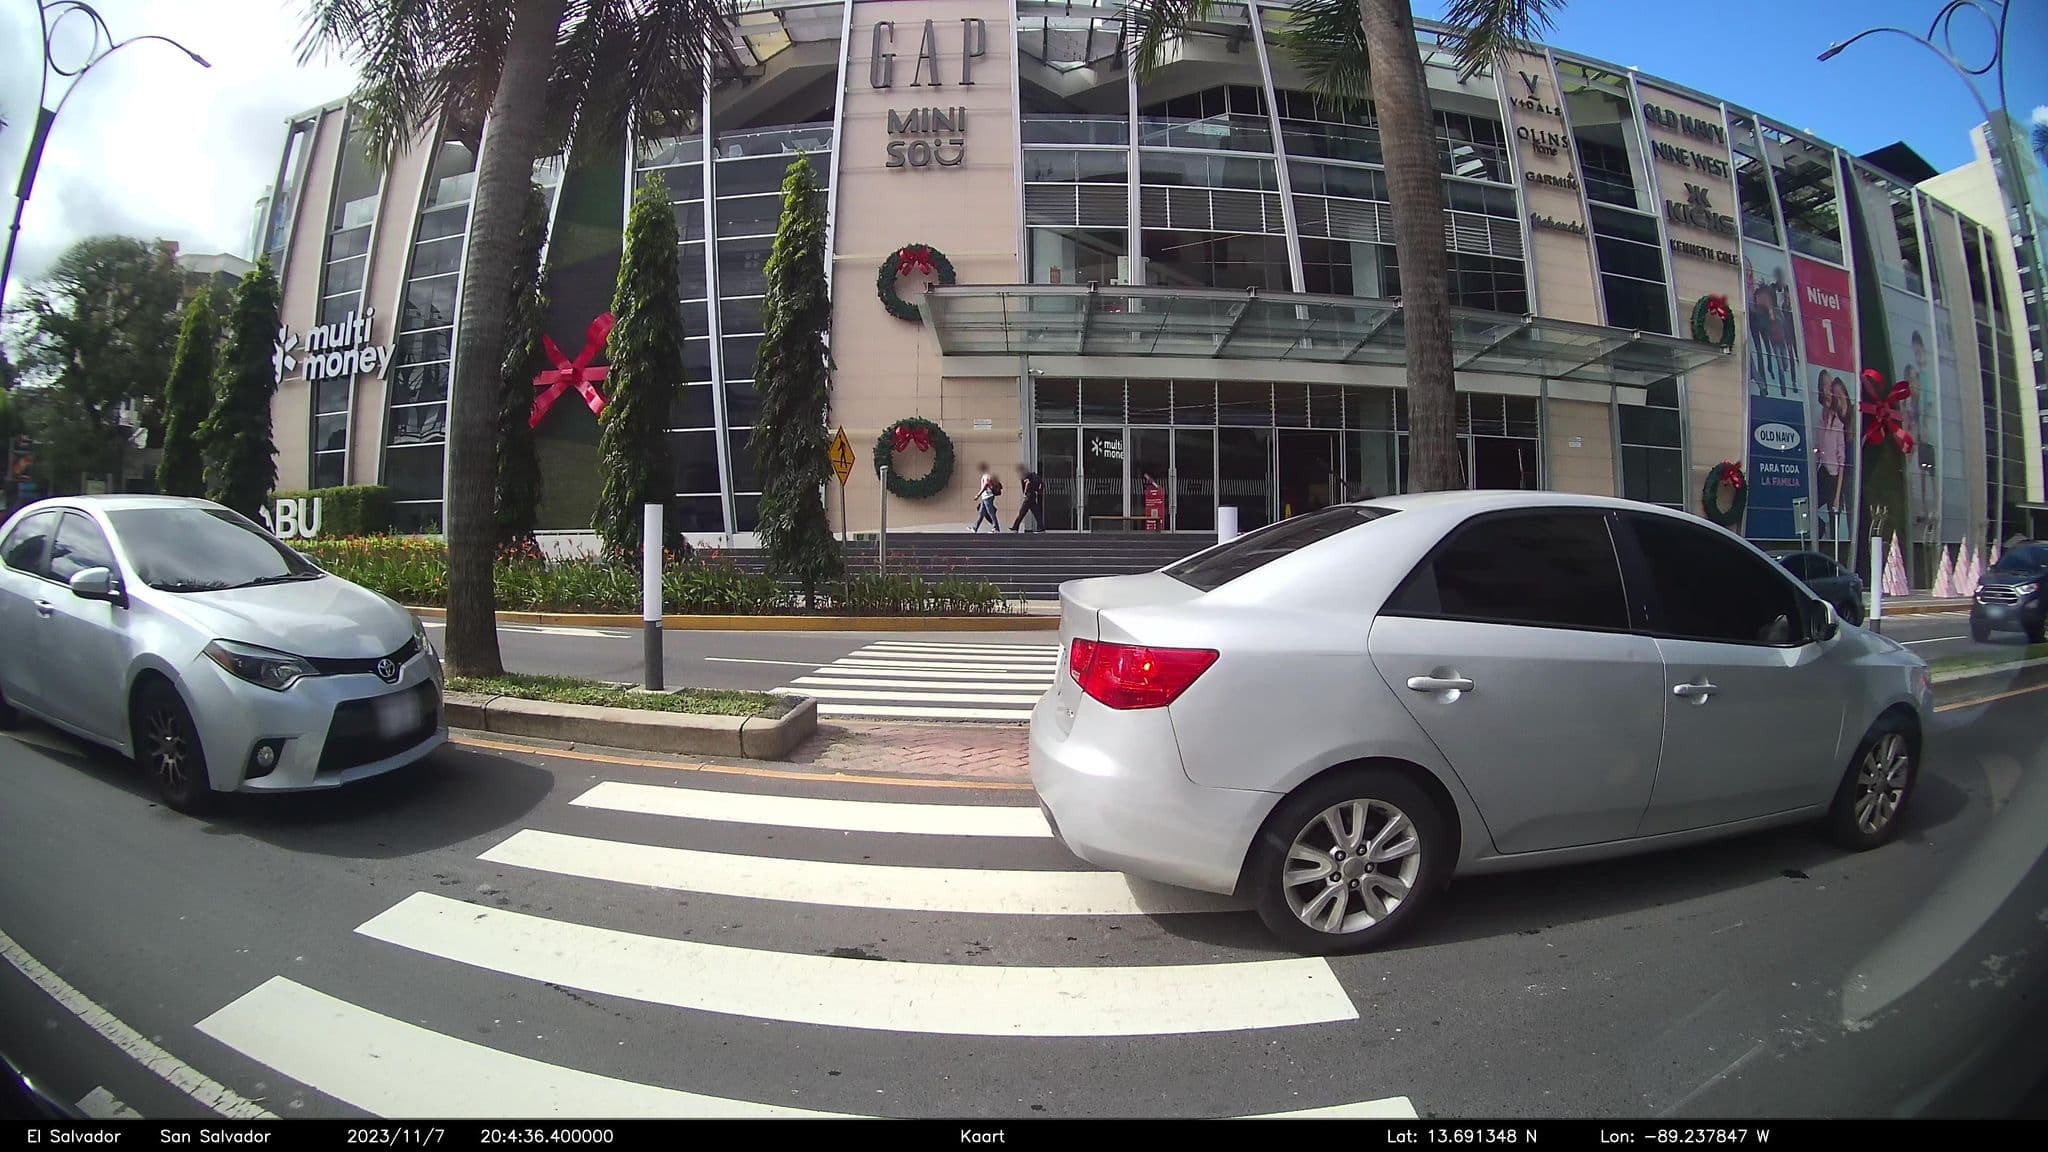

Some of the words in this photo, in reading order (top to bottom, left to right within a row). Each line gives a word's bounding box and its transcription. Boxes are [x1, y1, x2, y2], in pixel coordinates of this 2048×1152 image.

[870, 18, 986, 89] GAP
[887, 106, 967, 134] MINI
[1644, 103, 1679, 128] OLD
[1680, 114, 1724, 144] NAVY
[1652, 140, 1690, 167] NINE
[1690, 151, 1728, 179] WEST
[1525, 171, 1577, 190] GARMIN
[1670, 239, 1714, 260] KENNETH
[1716, 250, 1739, 266] COLE
[1806, 286, 1840, 310] Nivel
[304, 306, 375, 351] multi
[1822, 318, 1836, 353] 1
[301, 343, 396, 381] money
[1104, 439, 1123, 450] multi
[1760, 430, 1775, 442] OLD
[1776, 431, 1795, 443] NAVY
[1104, 450, 1126, 459] mone
[1760, 463, 1779, 473] PARA
[1780, 464, 1800, 474] TODA
[1761, 476, 1771, 486] LA
[1772, 477, 1800, 487] FAMILIA
